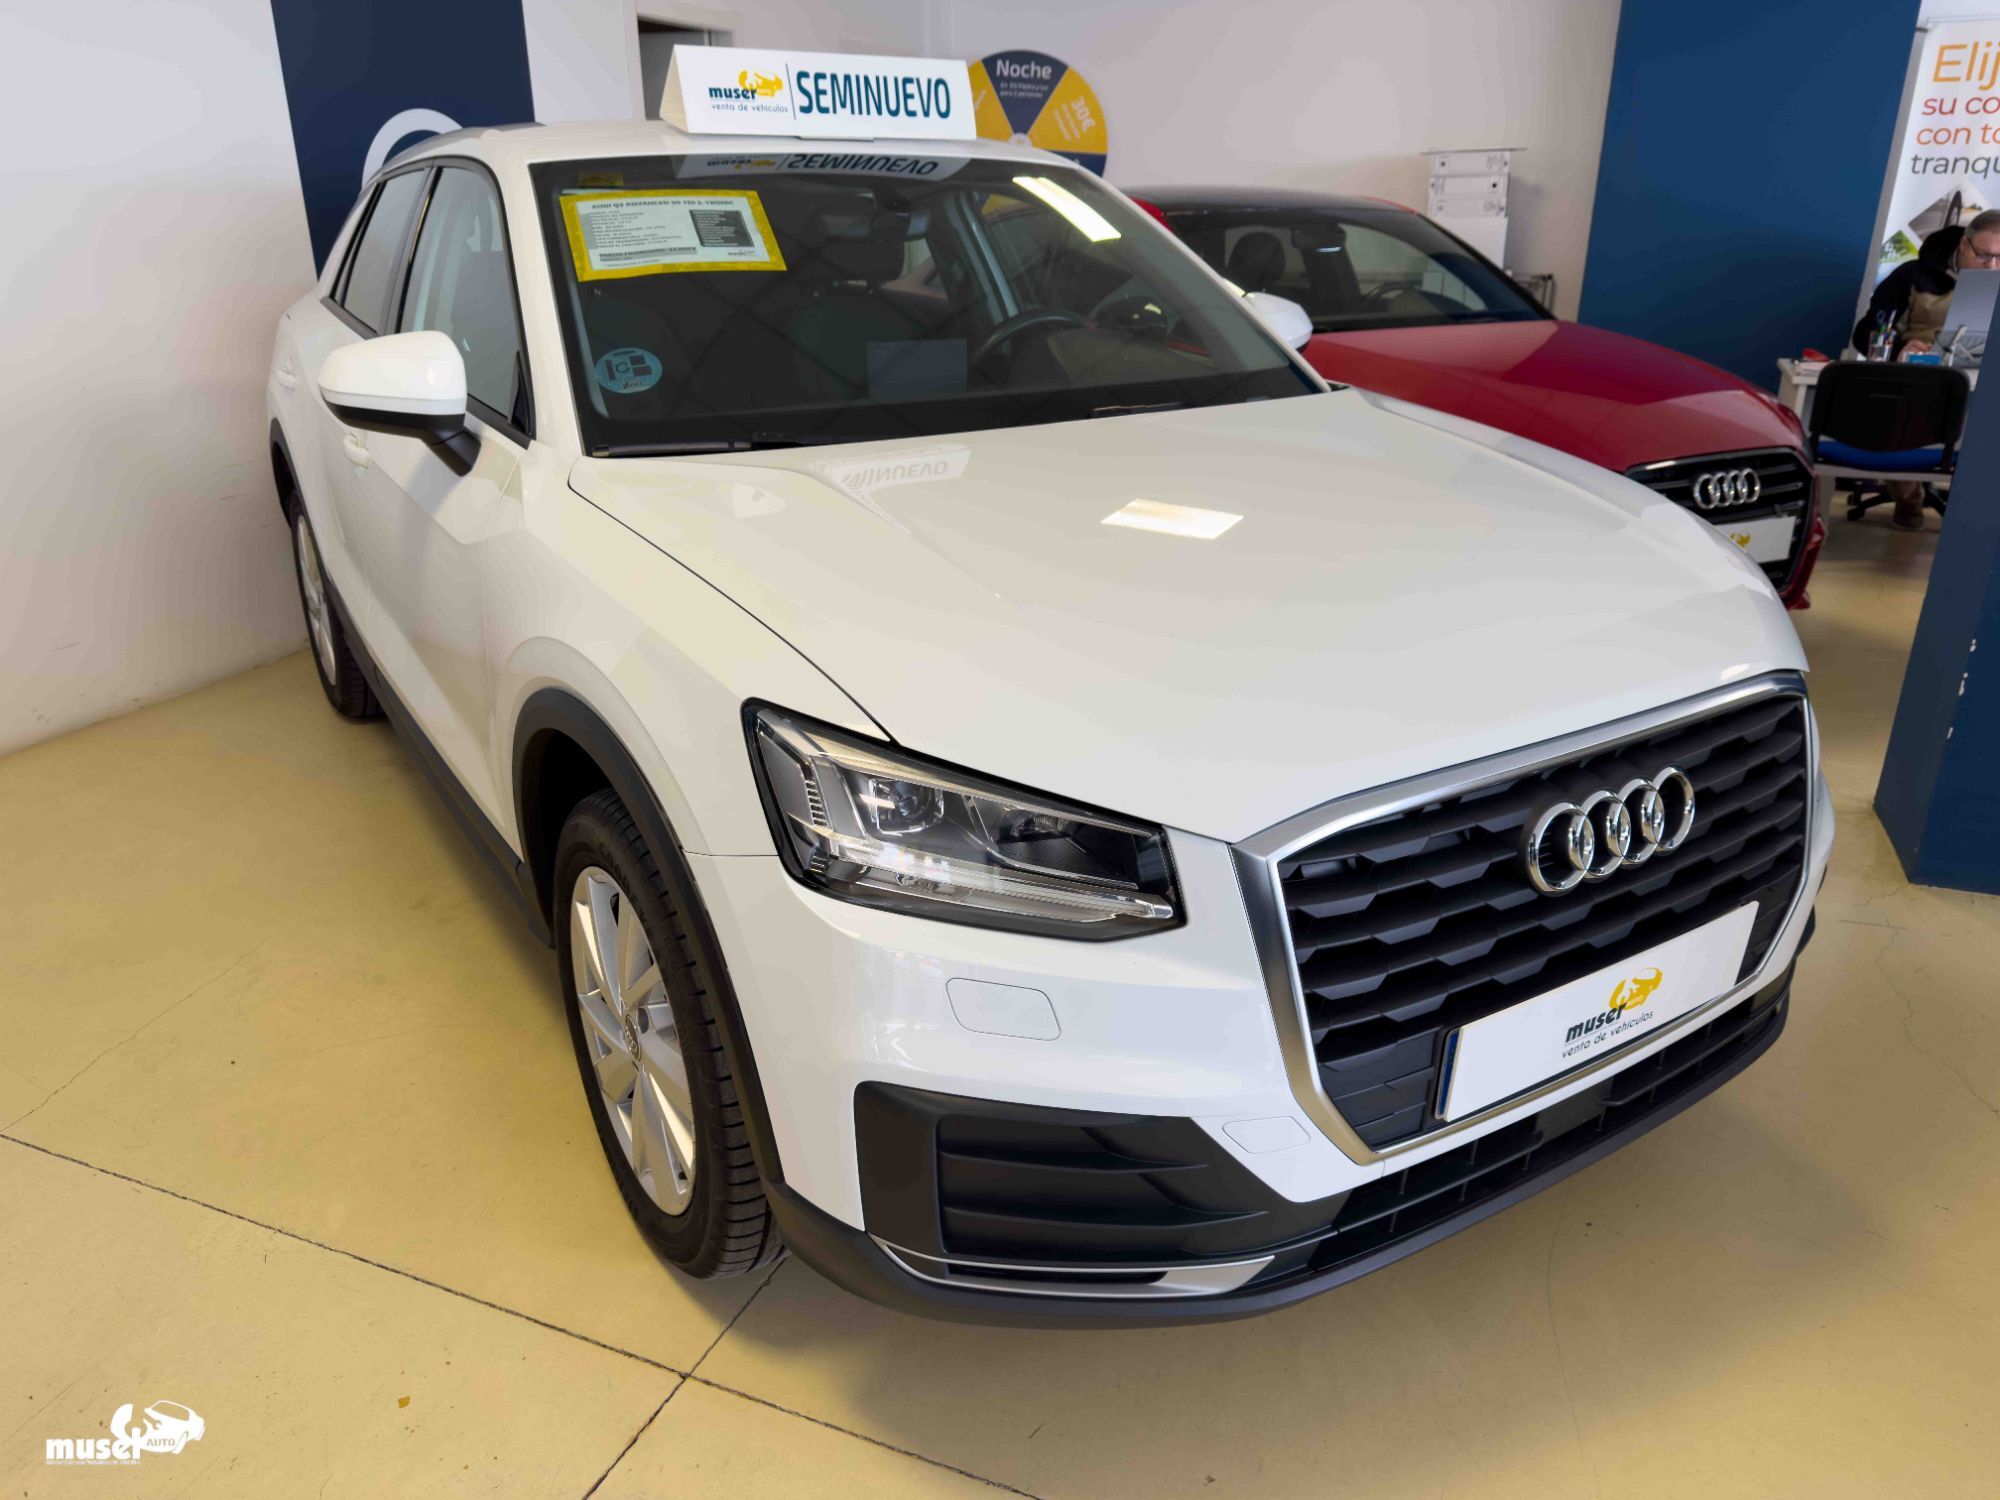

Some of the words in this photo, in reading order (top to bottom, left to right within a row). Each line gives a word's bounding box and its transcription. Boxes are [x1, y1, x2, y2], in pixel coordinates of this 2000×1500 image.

[996, 59, 1053, 79] Noche
[708, 84, 758, 101] muser
[796, 70, 951, 119] SEMINUEVO
[711, 103, 735, 111] venta
[738, 103, 750, 112] de
[1070, 96, 1096, 134] 30€
[1922, 97, 1957, 116] su
[1916, 127, 1972, 145] con
[1566, 1003, 1626, 1042] muser
[1563, 1041, 1591, 1057] venta
[1593, 1031, 1608, 1045] de
